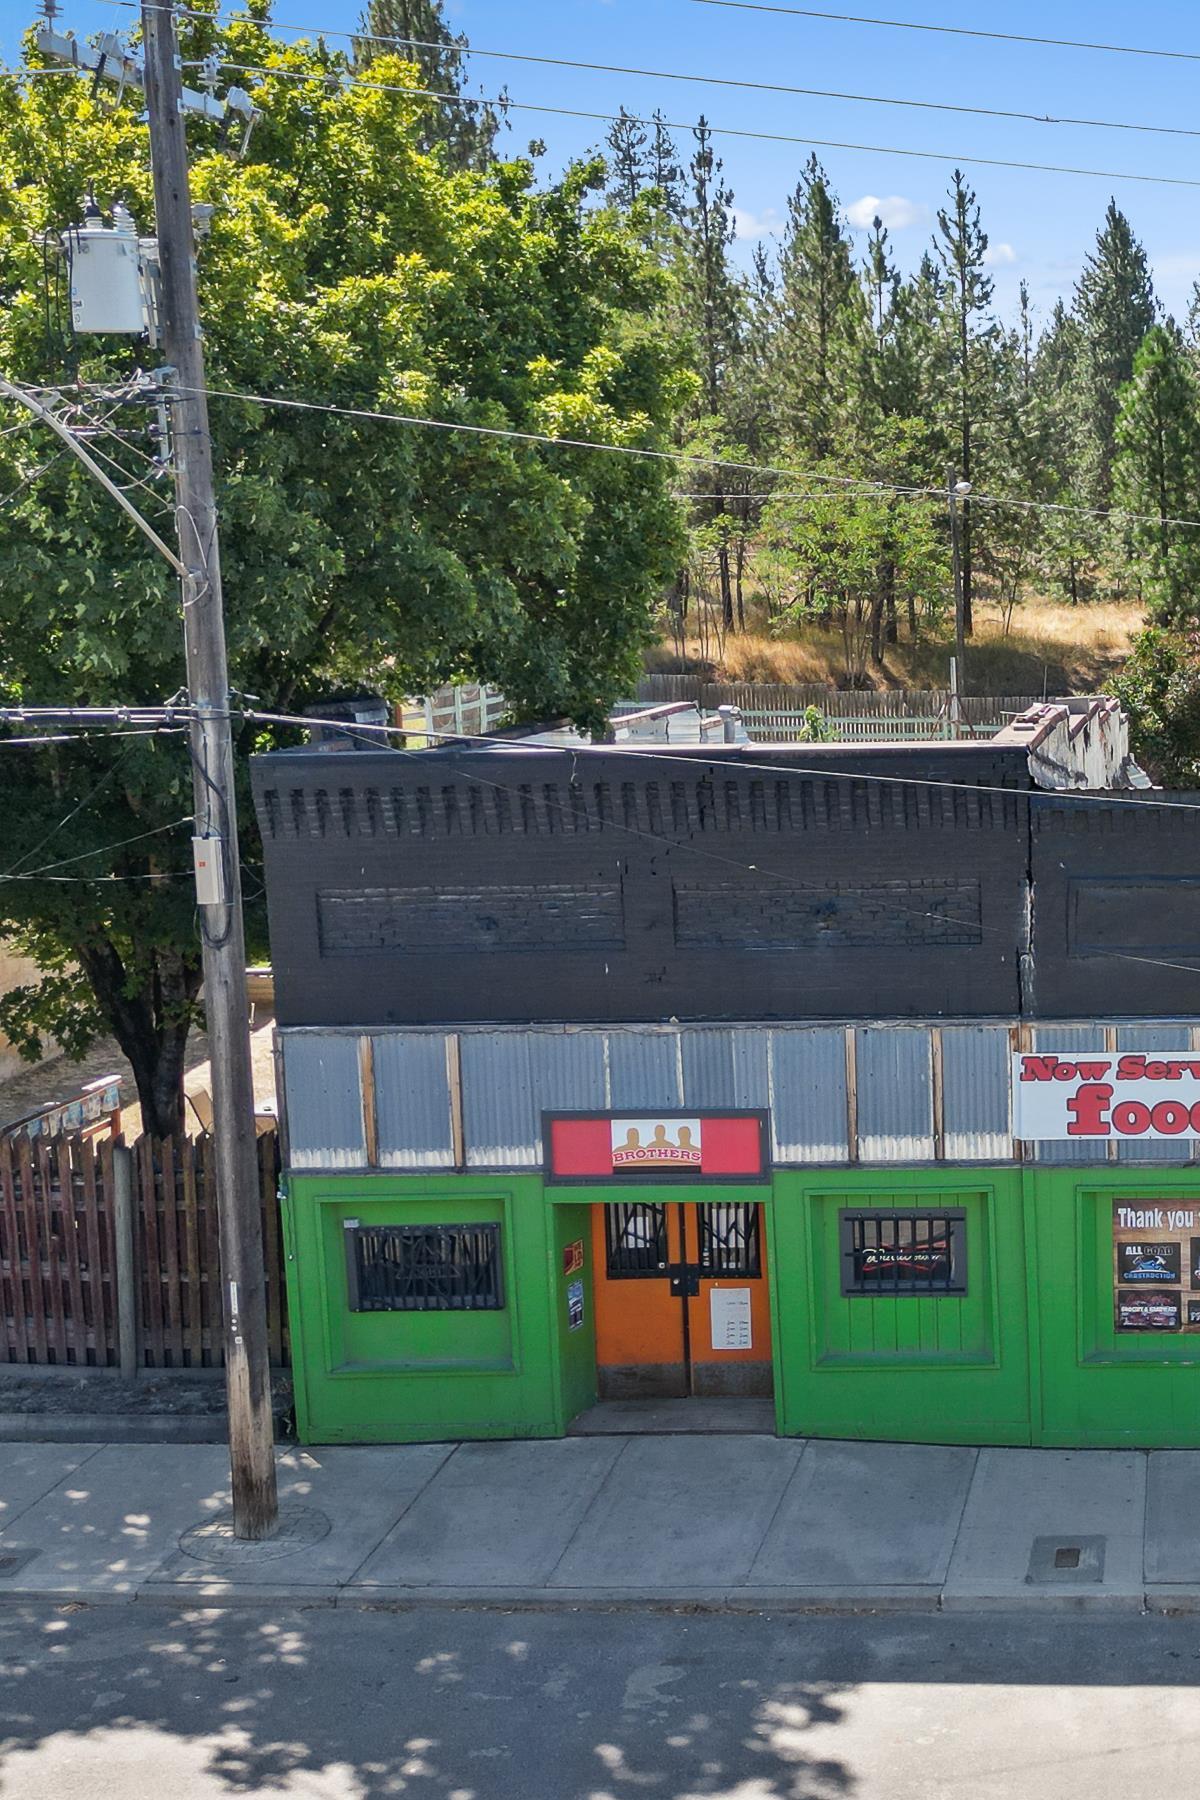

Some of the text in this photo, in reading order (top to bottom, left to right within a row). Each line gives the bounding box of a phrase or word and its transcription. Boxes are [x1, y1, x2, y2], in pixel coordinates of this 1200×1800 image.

[1019, 1055, 1112, 1081] Now
[613, 1148, 702, 1163] BROTHERS
[1117, 1207, 1163, 1228] Thank
[1167, 1210, 1194, 1231] you
